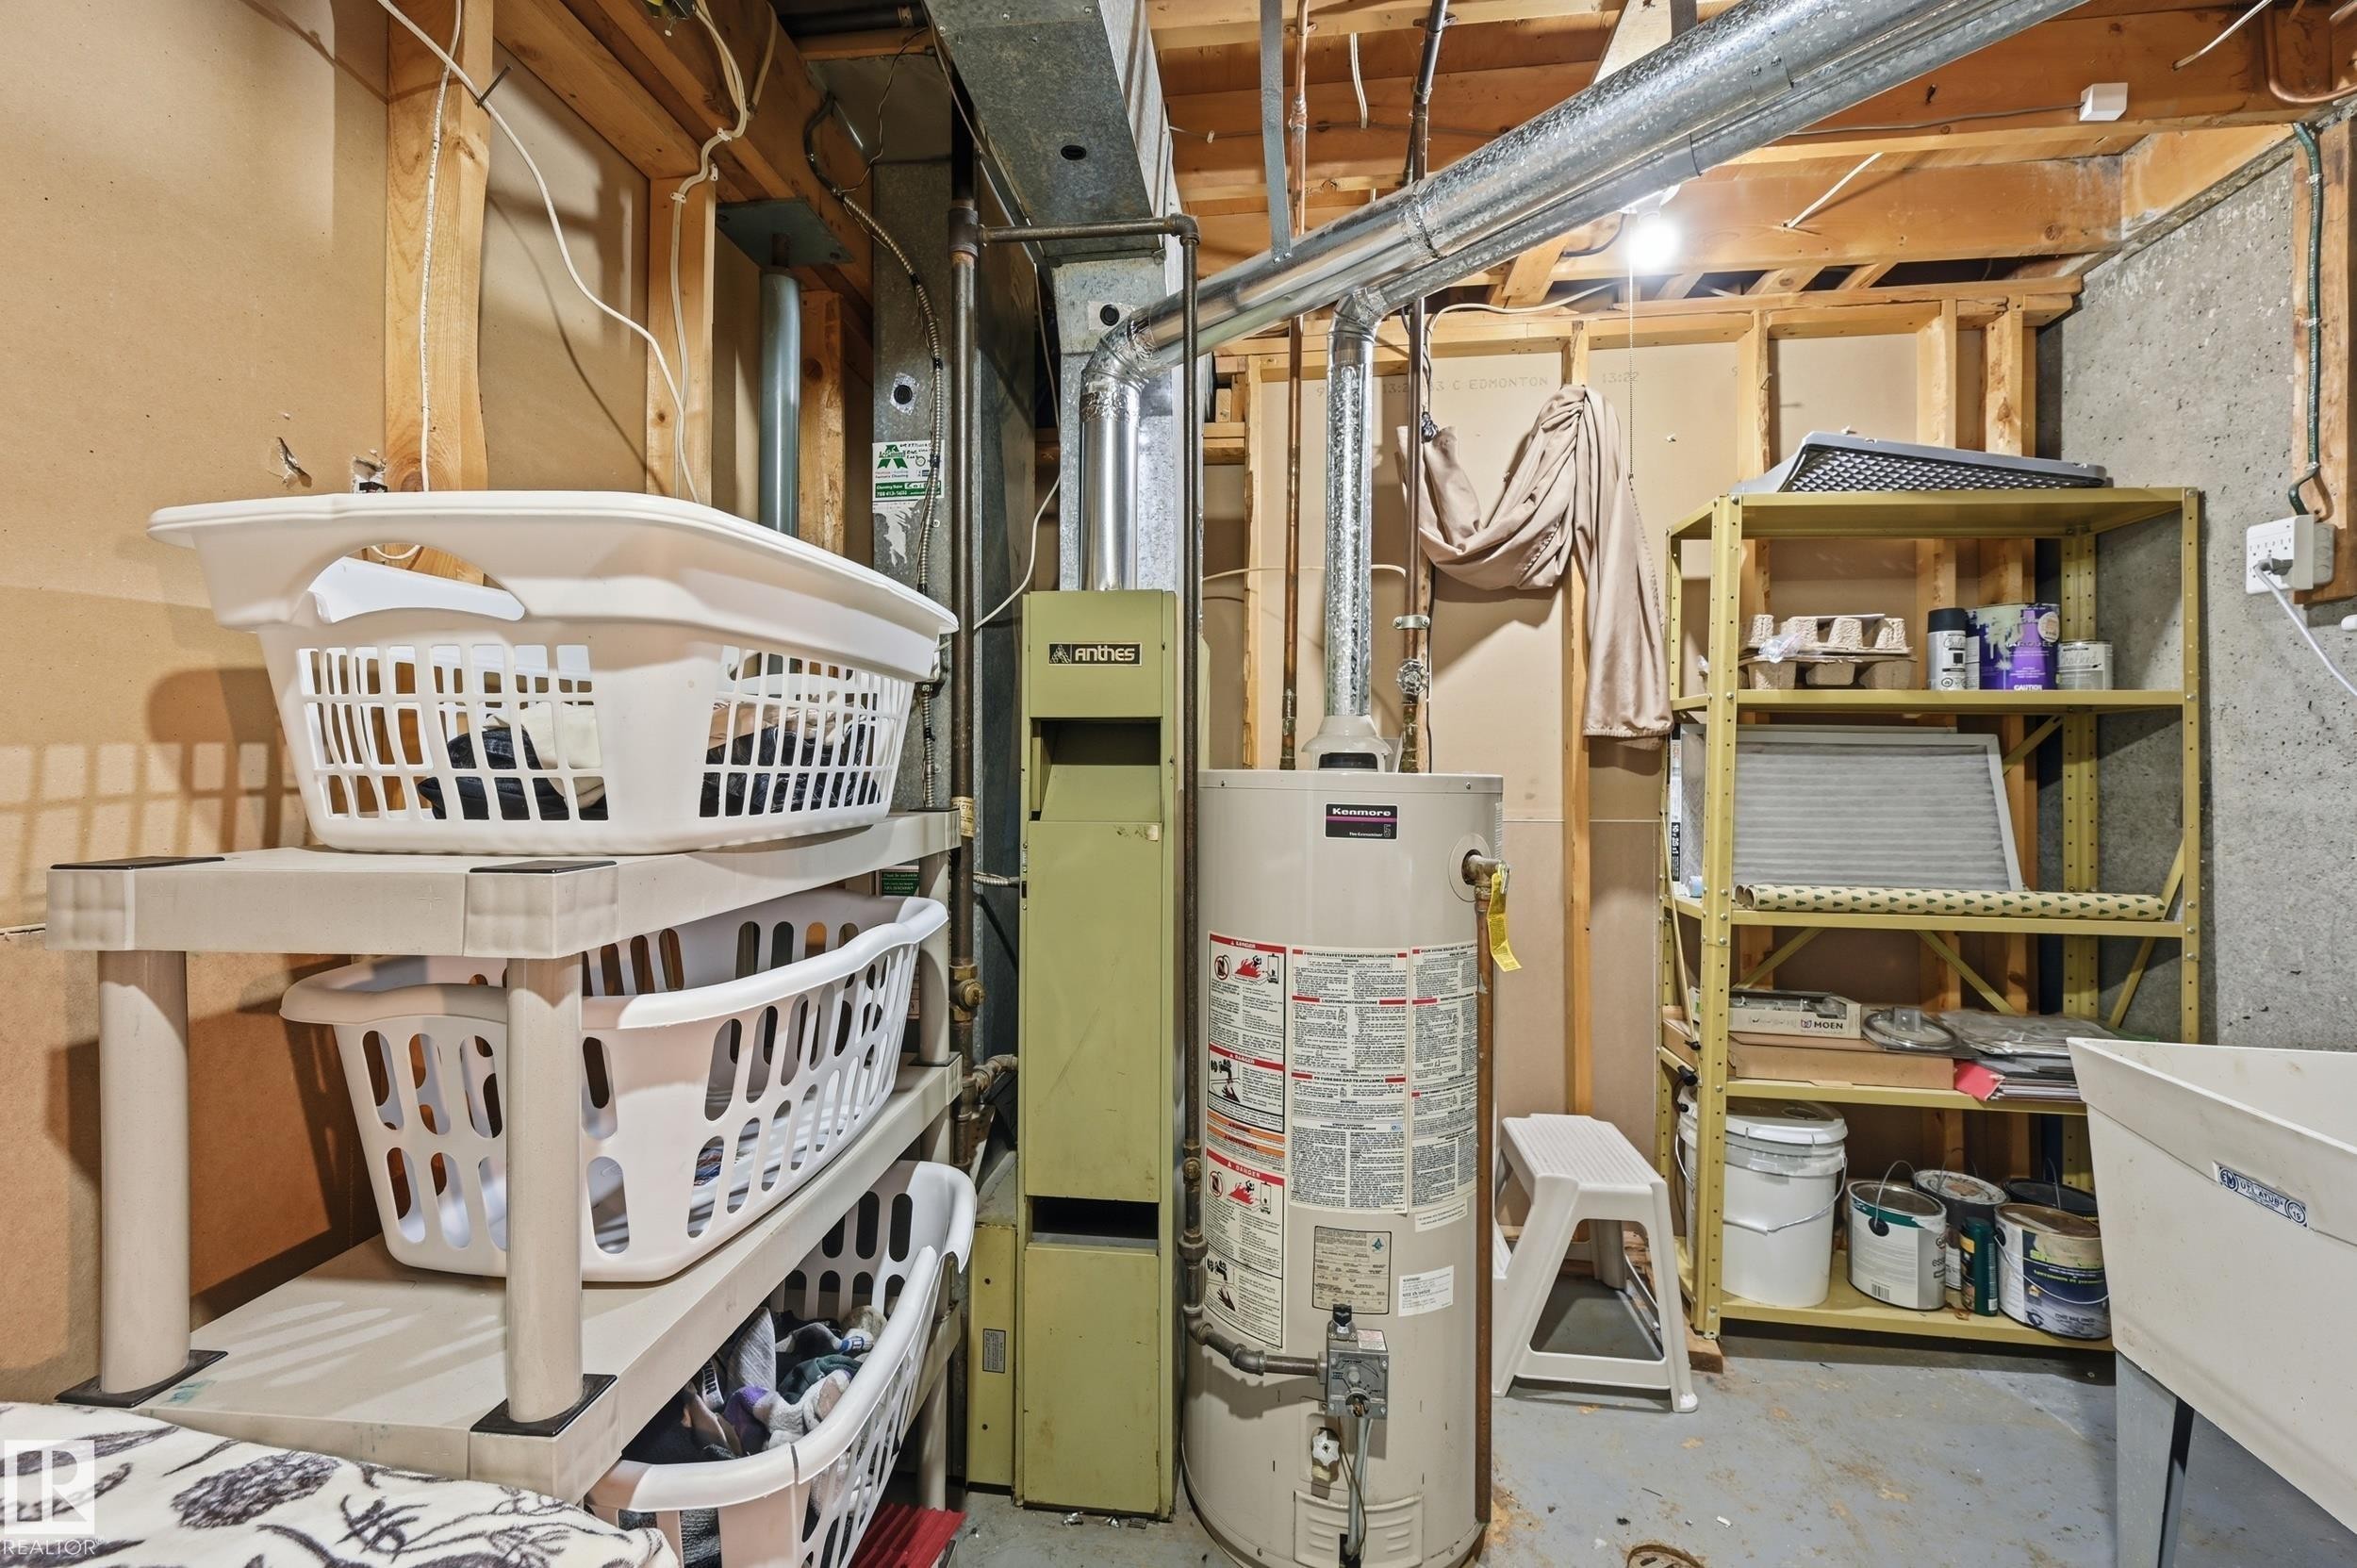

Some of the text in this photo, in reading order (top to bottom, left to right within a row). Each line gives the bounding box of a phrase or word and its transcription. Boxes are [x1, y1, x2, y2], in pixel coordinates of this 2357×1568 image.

[1469, 375, 1549, 390] EDMONTON
[1332, 807, 1392, 817] Kenmore
[1814, 1021, 1843, 1030] MOEN
[1236, 1165, 1261, 1179] DANGER
